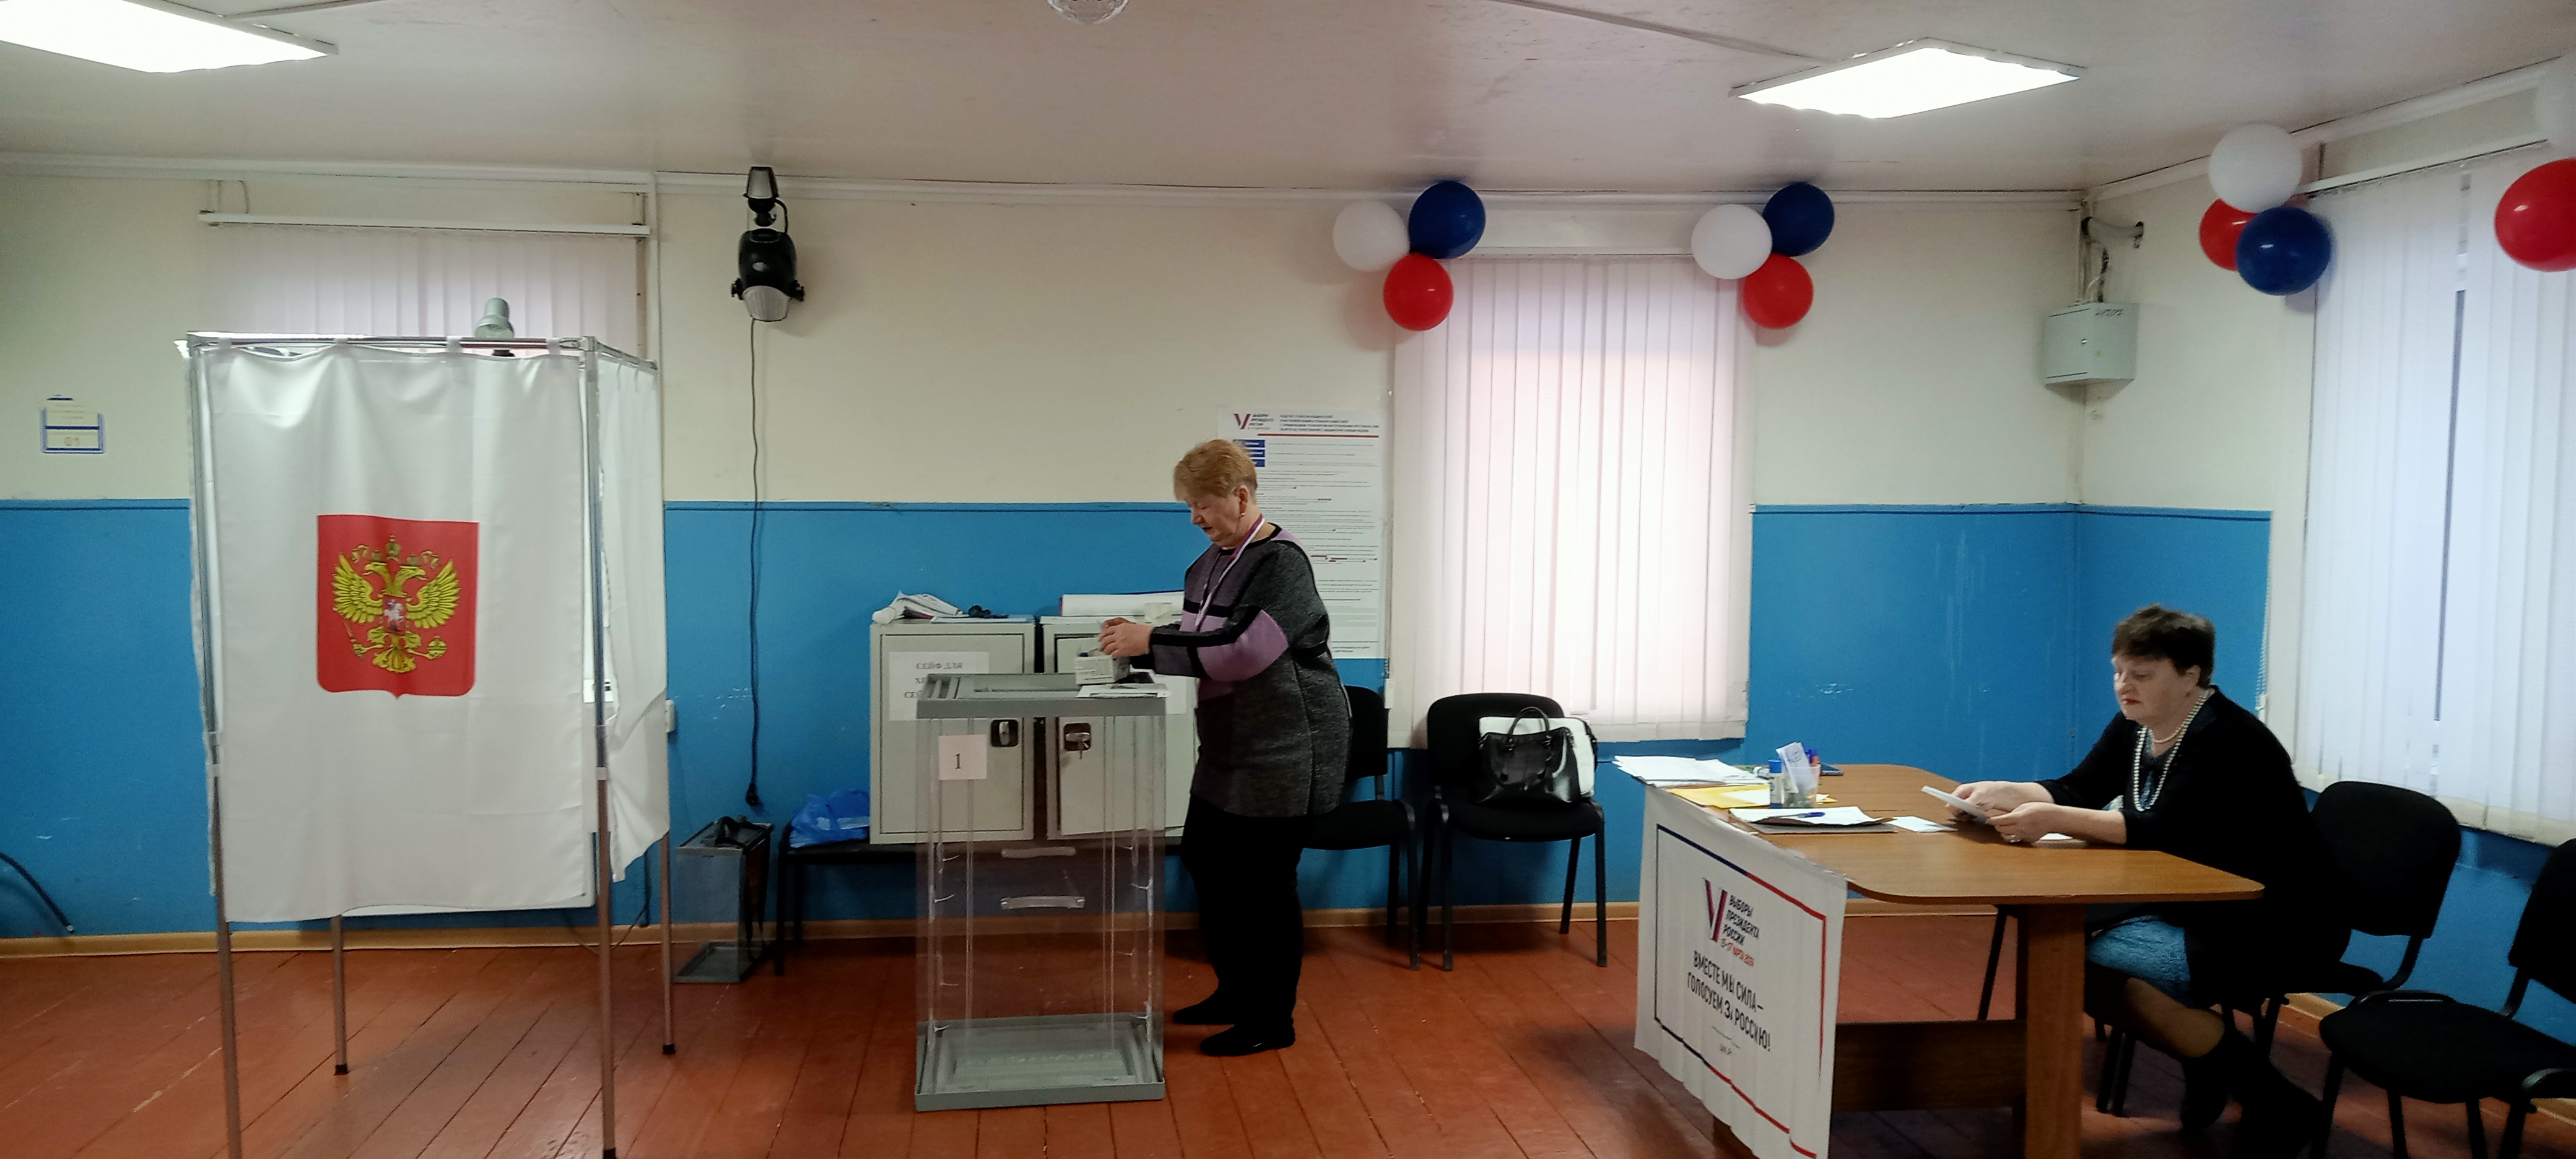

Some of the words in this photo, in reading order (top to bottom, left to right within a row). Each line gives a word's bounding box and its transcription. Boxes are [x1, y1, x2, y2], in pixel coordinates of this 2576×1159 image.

[954, 753, 961, 770] 1
[1687, 971, 1723, 1015] ГОЛОСУЕМ
[1734, 1007, 1771, 1052] РОССИЮ!
[1694, 950, 1721, 985] ВМЕСТЕ
[1736, 981, 1757, 1013] СИЛА
